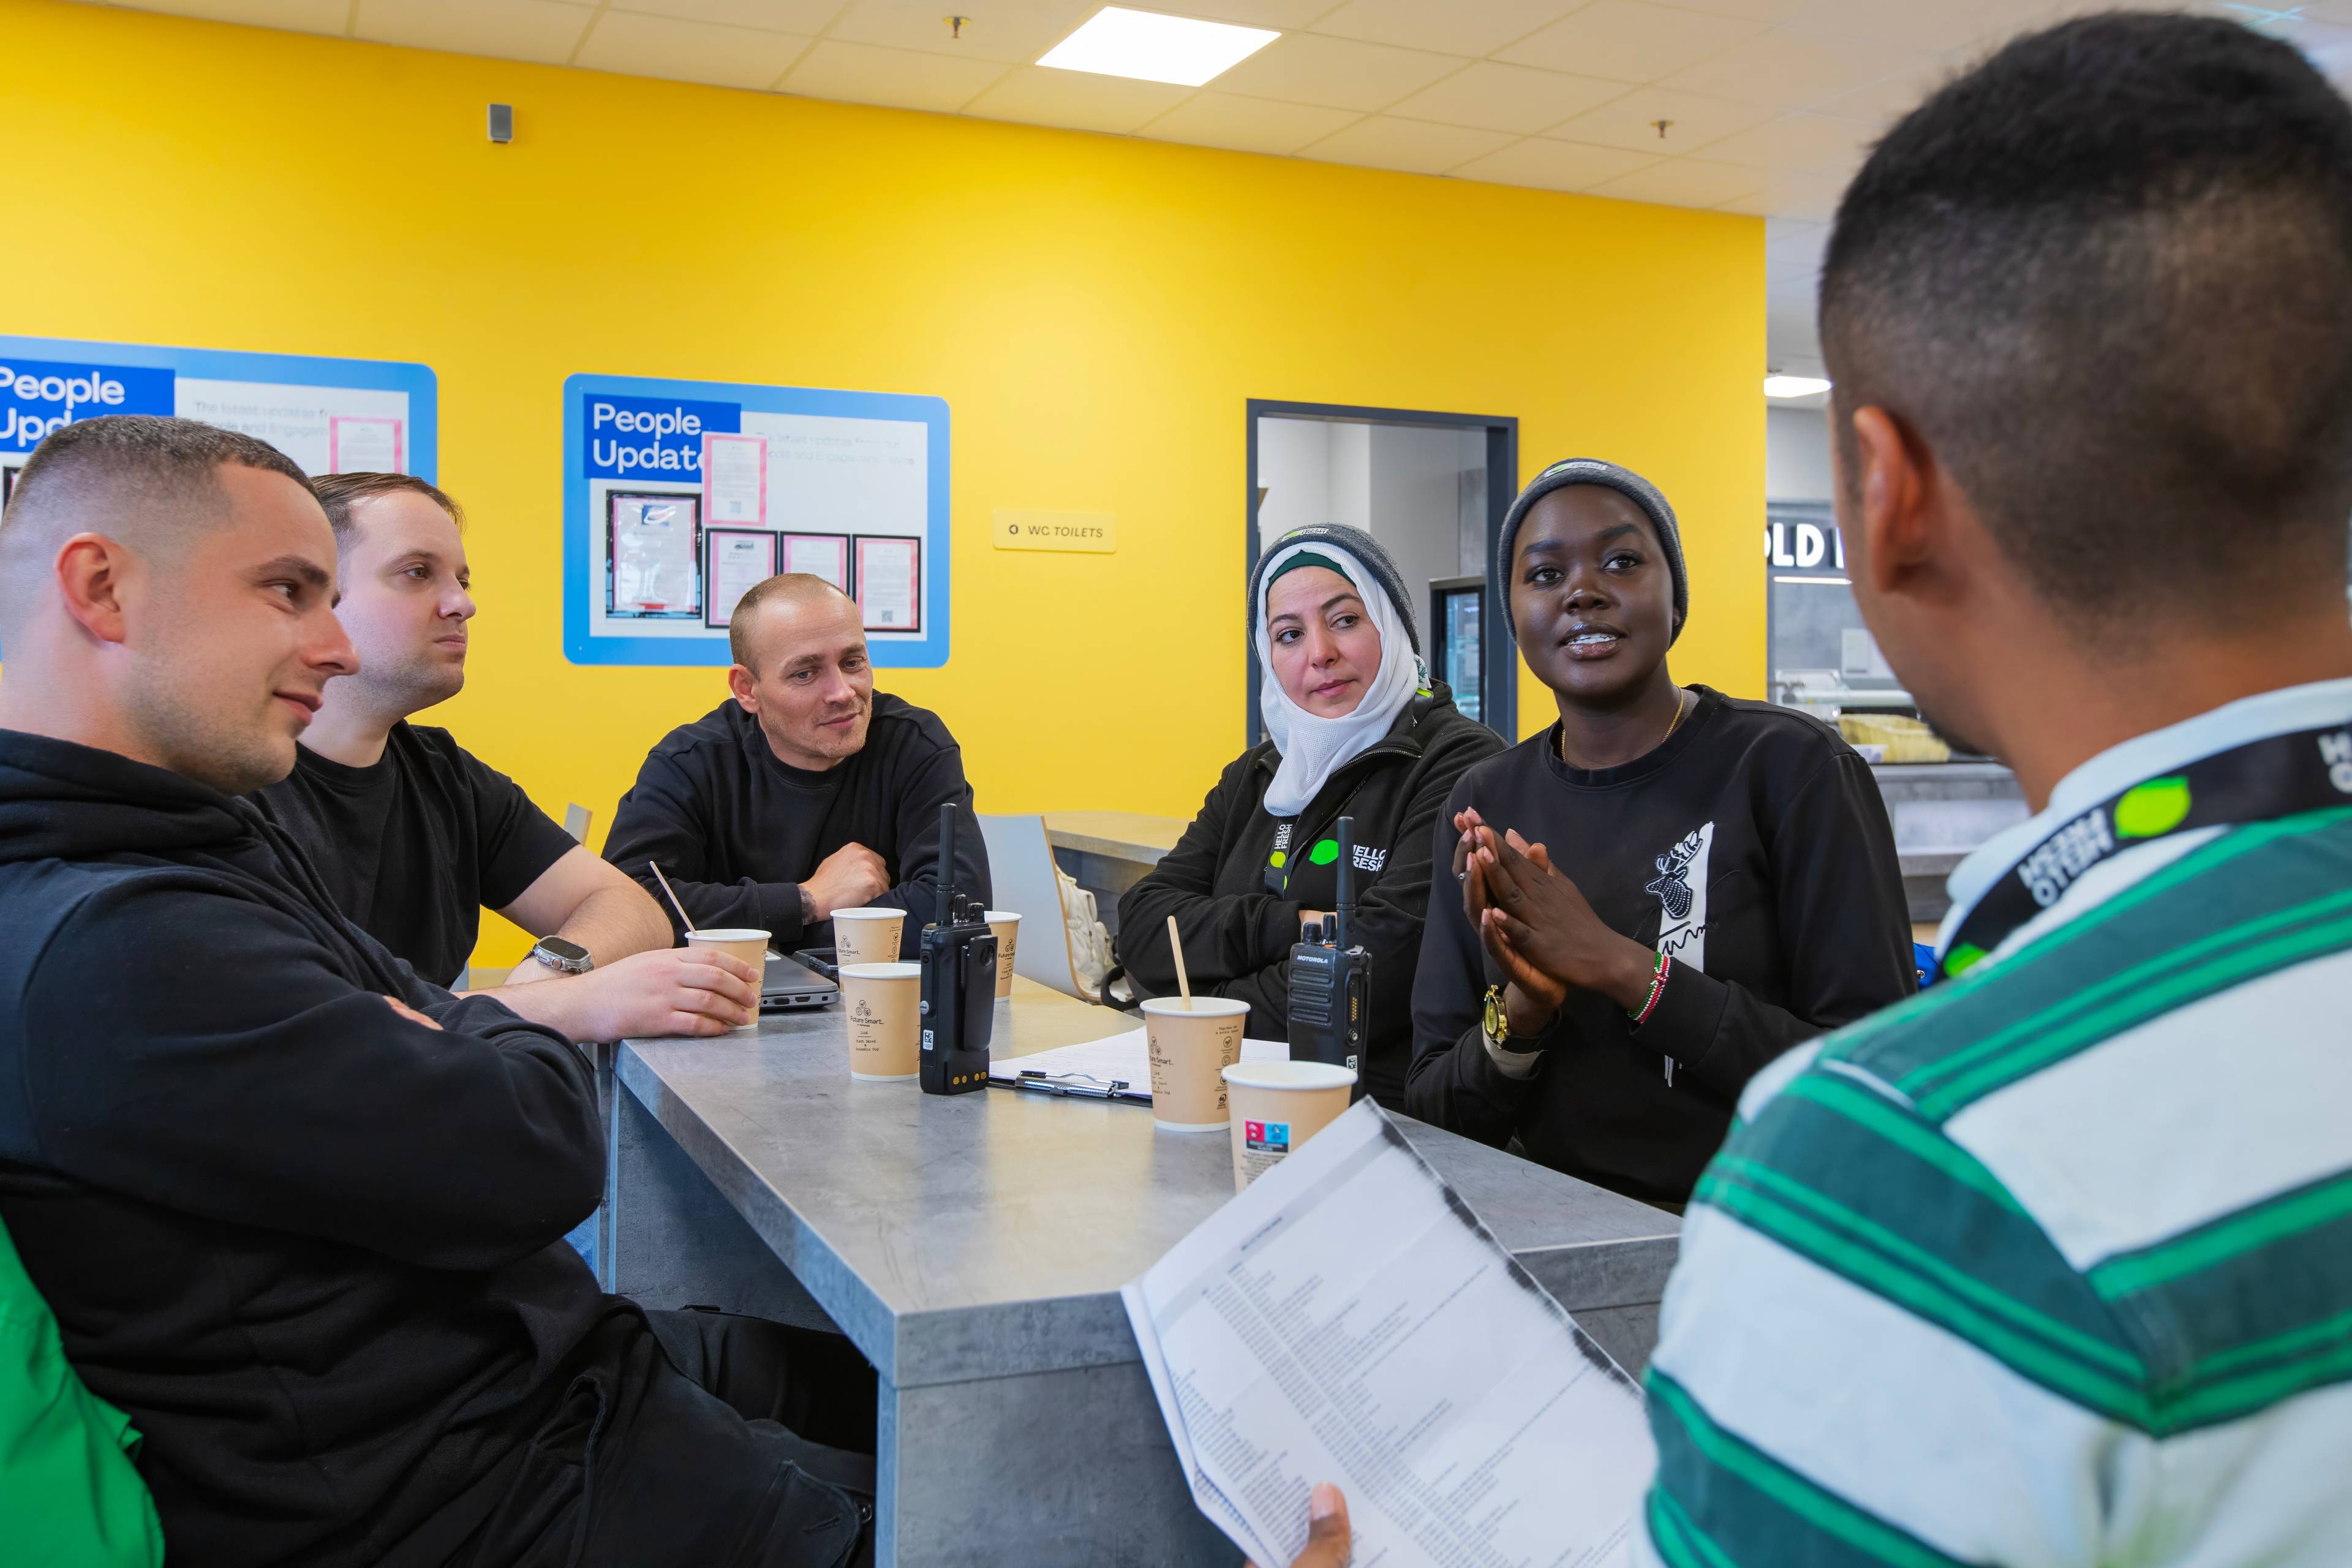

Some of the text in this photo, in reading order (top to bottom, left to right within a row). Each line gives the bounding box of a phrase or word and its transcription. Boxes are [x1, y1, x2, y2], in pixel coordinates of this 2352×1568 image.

[594, 402, 701, 440] People
[594, 439, 702, 475] Updat
[1028, 525, 1103, 538] WC TOILETS
[1274, 824, 1286, 850] HELLO
[1281, 824, 1293, 849] FRESH
[1353, 856, 1383, 872] RESH
[1297, 955, 1329, 963] MOTOROLA
